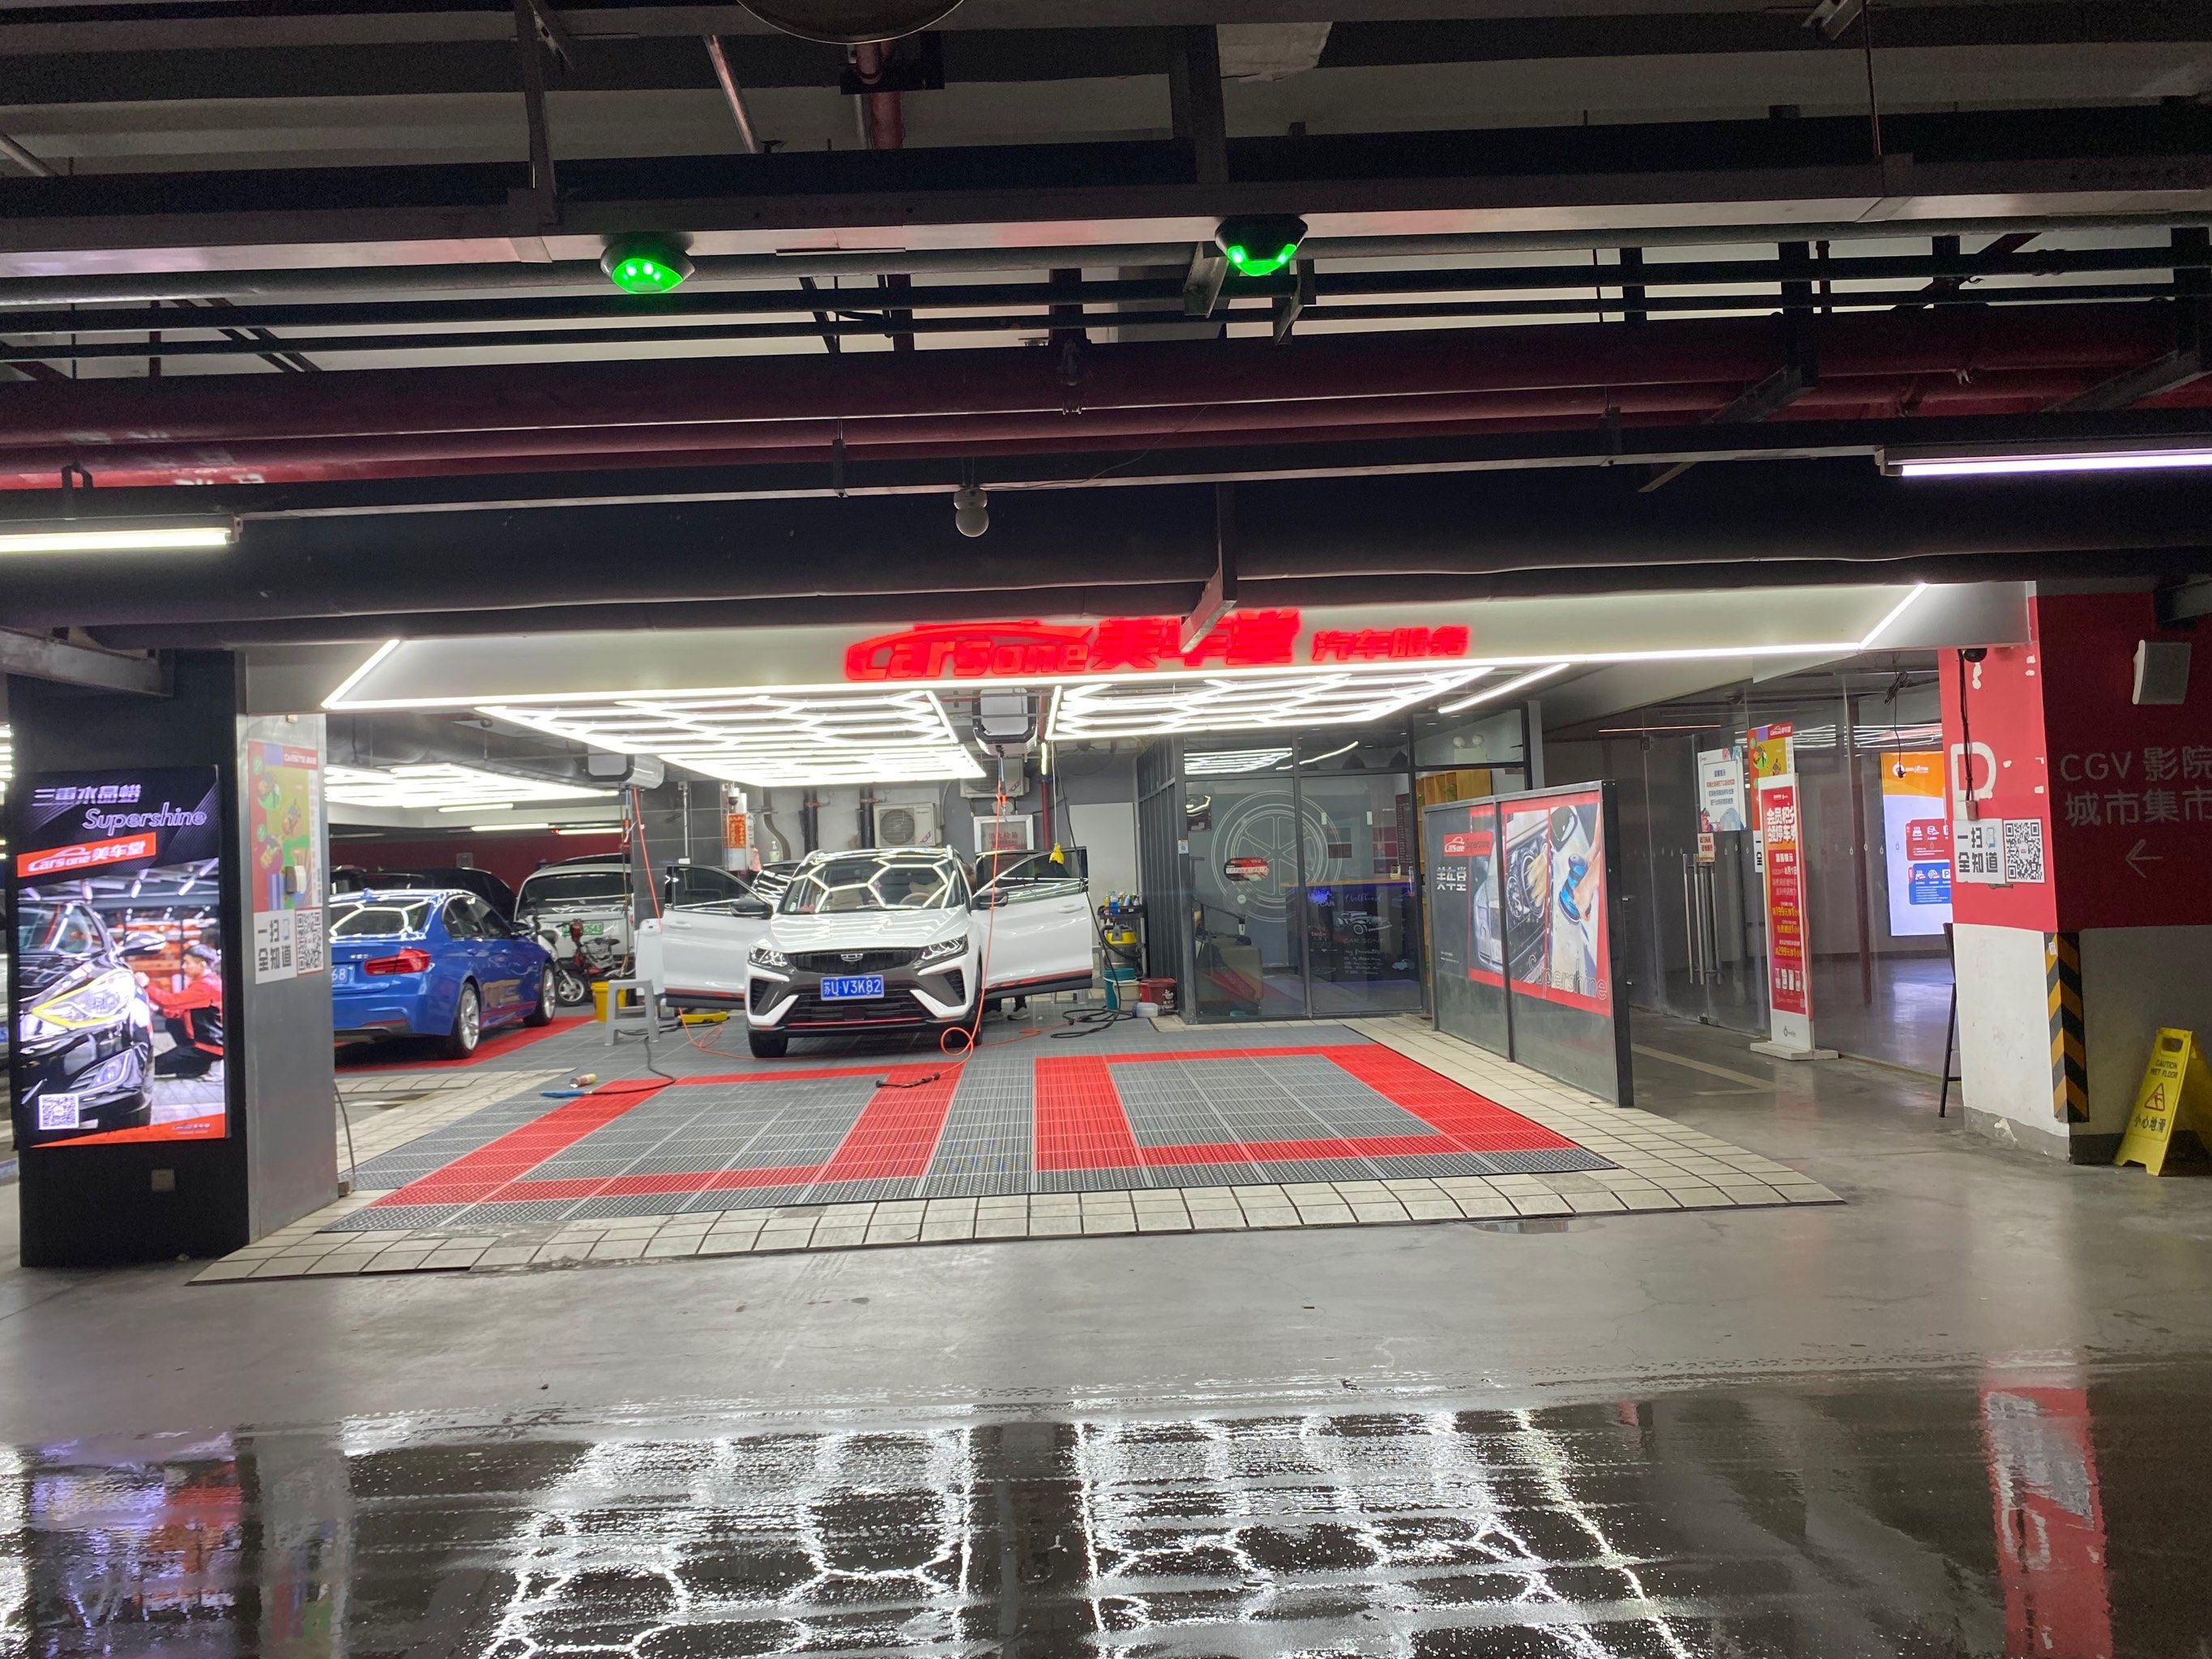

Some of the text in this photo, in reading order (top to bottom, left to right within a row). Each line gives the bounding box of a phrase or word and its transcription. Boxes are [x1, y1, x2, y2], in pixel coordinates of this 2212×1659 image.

[1312, 625, 1468, 661] 汽车服务
[2060, 744, 2212, 782] CGV 影院
[83, 802, 207, 836] Supershine
[2065, 786, 2212, 827] 城市集市
[1958, 827, 1983, 848] 一扫
[91, 841, 145, 860] 美车堂
[1958, 851, 1998, 872] 全知道
[1437, 866, 1467, 891] 美车堂
[258, 919, 280, 942] 一扫
[258, 945, 292, 971] 全知道
[1528, 954, 1608, 1000] Supershine
[2150, 1068, 2178, 1078] WET FLOOR
[2155, 1060, 2177, 1068] CAUTION
